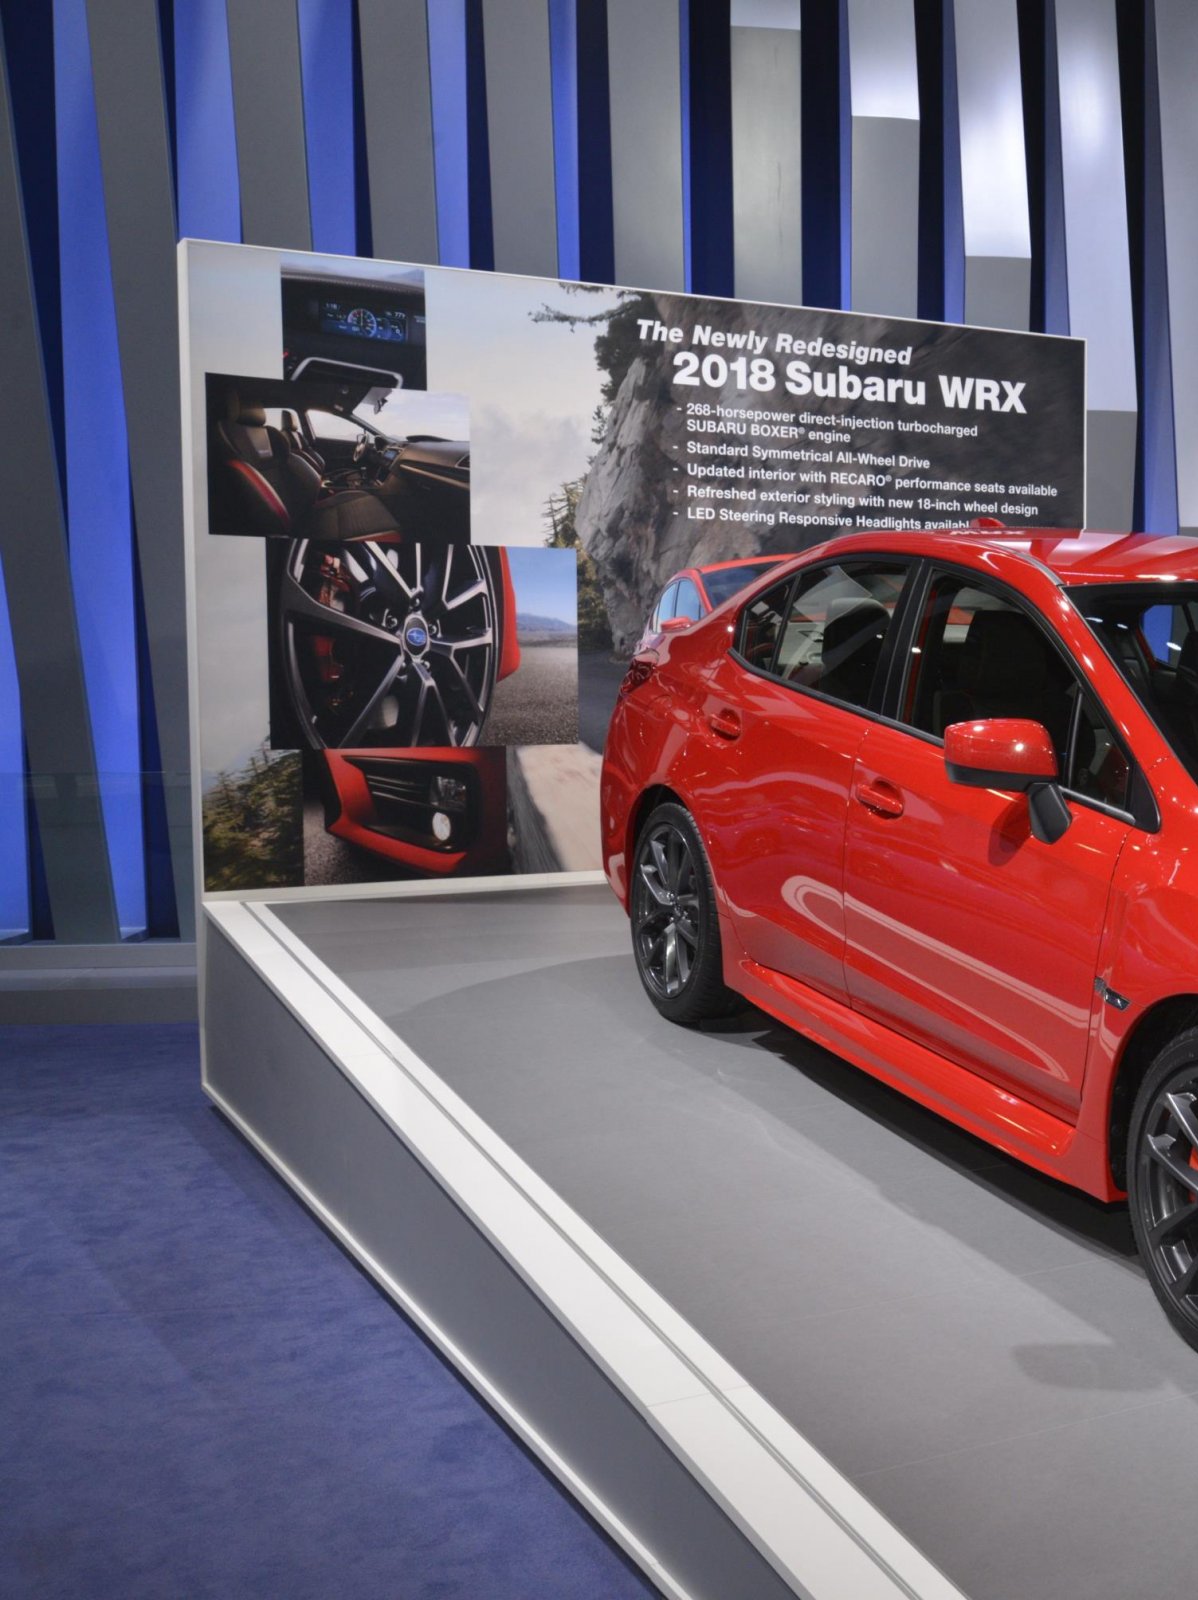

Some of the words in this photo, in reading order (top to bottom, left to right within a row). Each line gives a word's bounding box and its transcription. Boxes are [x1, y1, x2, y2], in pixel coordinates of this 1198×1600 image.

[636, 318, 684, 343] The
[692, 324, 768, 355] Newly
[775, 332, 913, 366] Redesigned
[672, 351, 776, 392] 2018
[785, 360, 926, 406] Subaru
[938, 374, 1027, 414] WRX
[686, 402, 796, 423] 268-horsepower
[799, 411, 895, 430] direct-injection
[897, 419, 978, 438] turbocharged
[686, 419, 747, 435] SUBARU
[808, 430, 851, 444] engine
[686, 441, 748, 457] Standard
[752, 446, 833, 462] Symmetrical
[836, 451, 895, 467] All-Wheel
[899, 455, 931, 469] Drive
[687, 463, 745, 478] Updated
[748, 467, 796, 482] interior
[800, 470, 827, 484] with
[895, 477, 971, 492] performance
[974, 481, 1005, 494] seats
[1008, 483, 1058, 497] available
[687, 485, 756, 501] Refreshed
[759, 490, 810, 504] exterior
[814, 493, 855, 508] styling
[859, 495, 886, 508] with
[888, 499, 913, 510] new
[917, 498, 961, 512] 18-inch
[964, 500, 998, 514] wheel
[1001, 502, 1038, 517] design
[687, 507, 716, 521] LED
[719, 508, 775, 526] Steering
[779, 511, 853, 527] Responsive
[856, 514, 921, 531] Headlights
